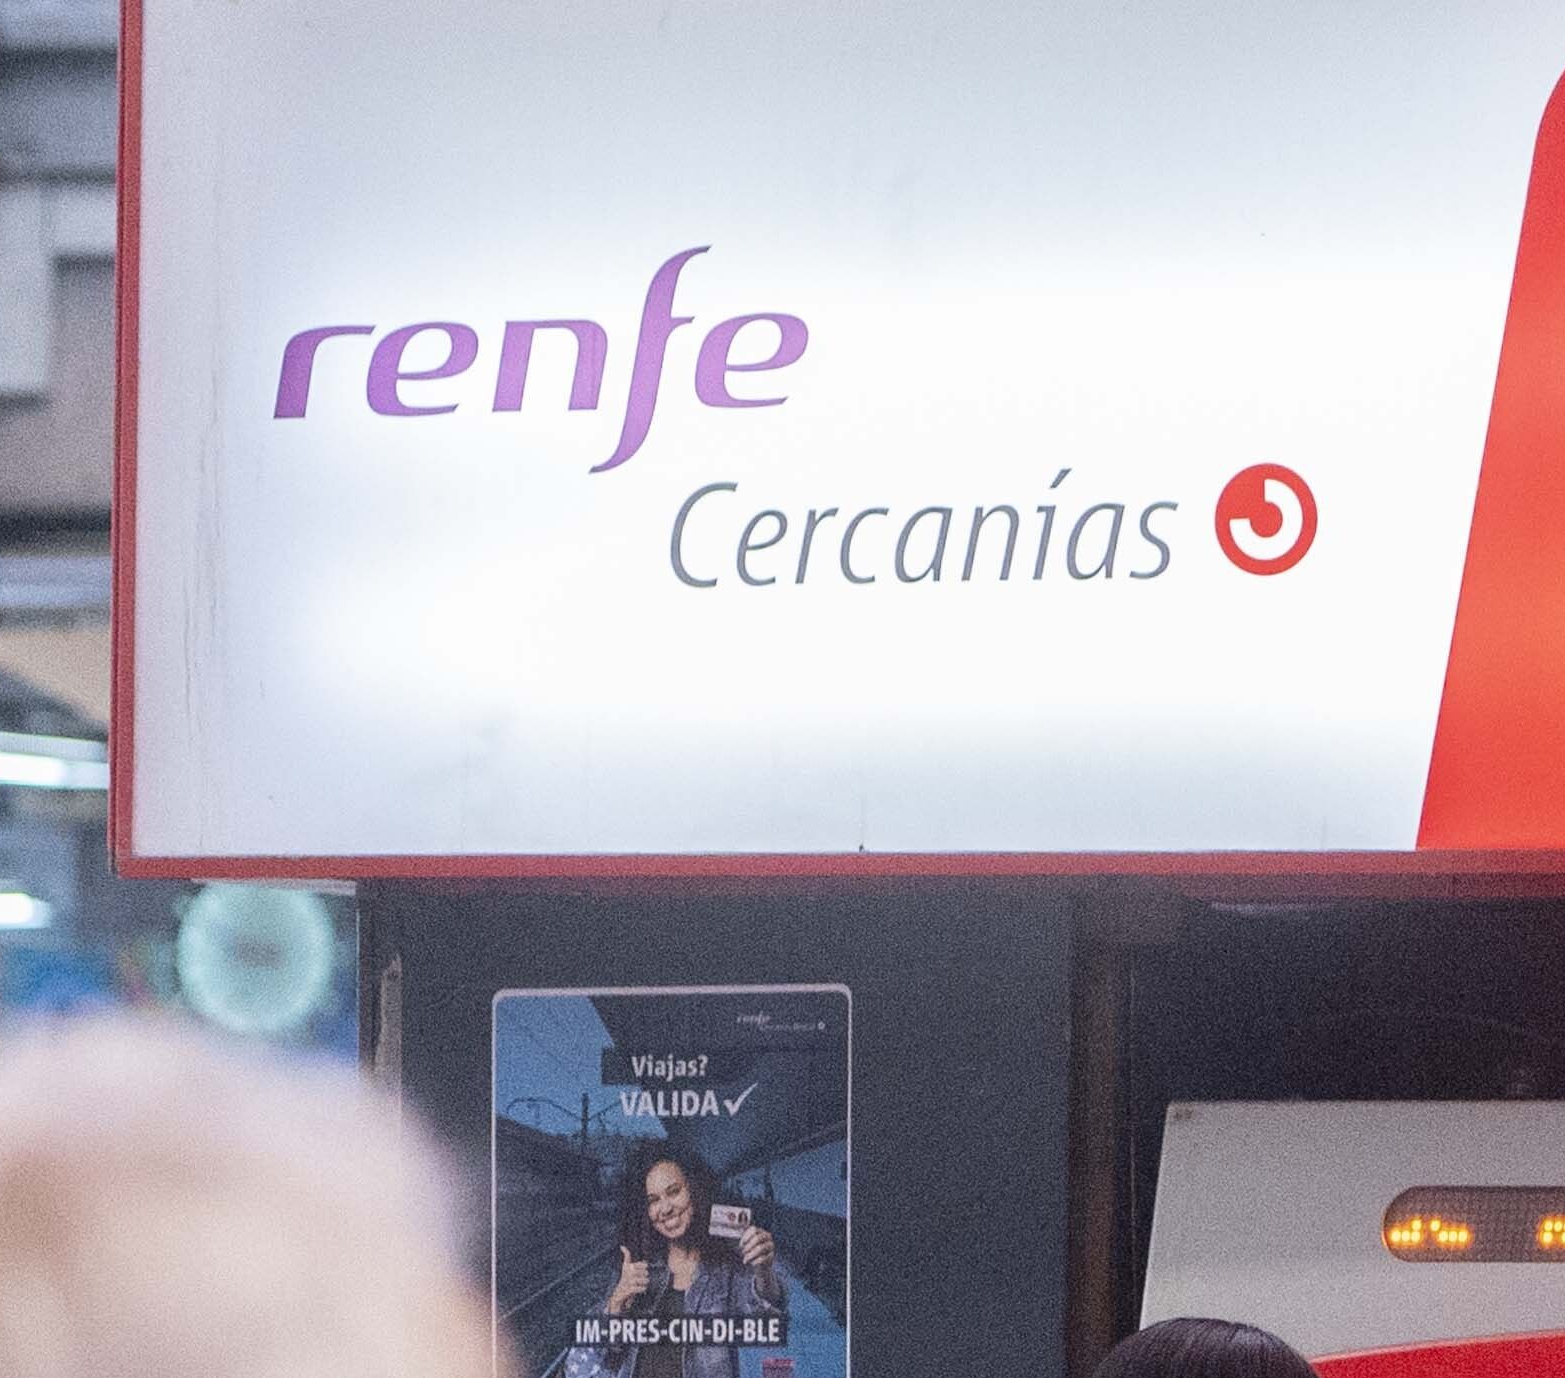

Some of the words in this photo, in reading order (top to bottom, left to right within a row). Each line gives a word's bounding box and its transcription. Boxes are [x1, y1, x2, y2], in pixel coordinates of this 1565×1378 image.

[272, 244, 810, 474] renfe
[668, 467, 1179, 588] Cercanías
[630, 1053, 709, 1083] Viajas?
[620, 1089, 721, 1117] VALIDA
[575, 1317, 781, 1344] IM-PRES-CIN-DI-BLE
